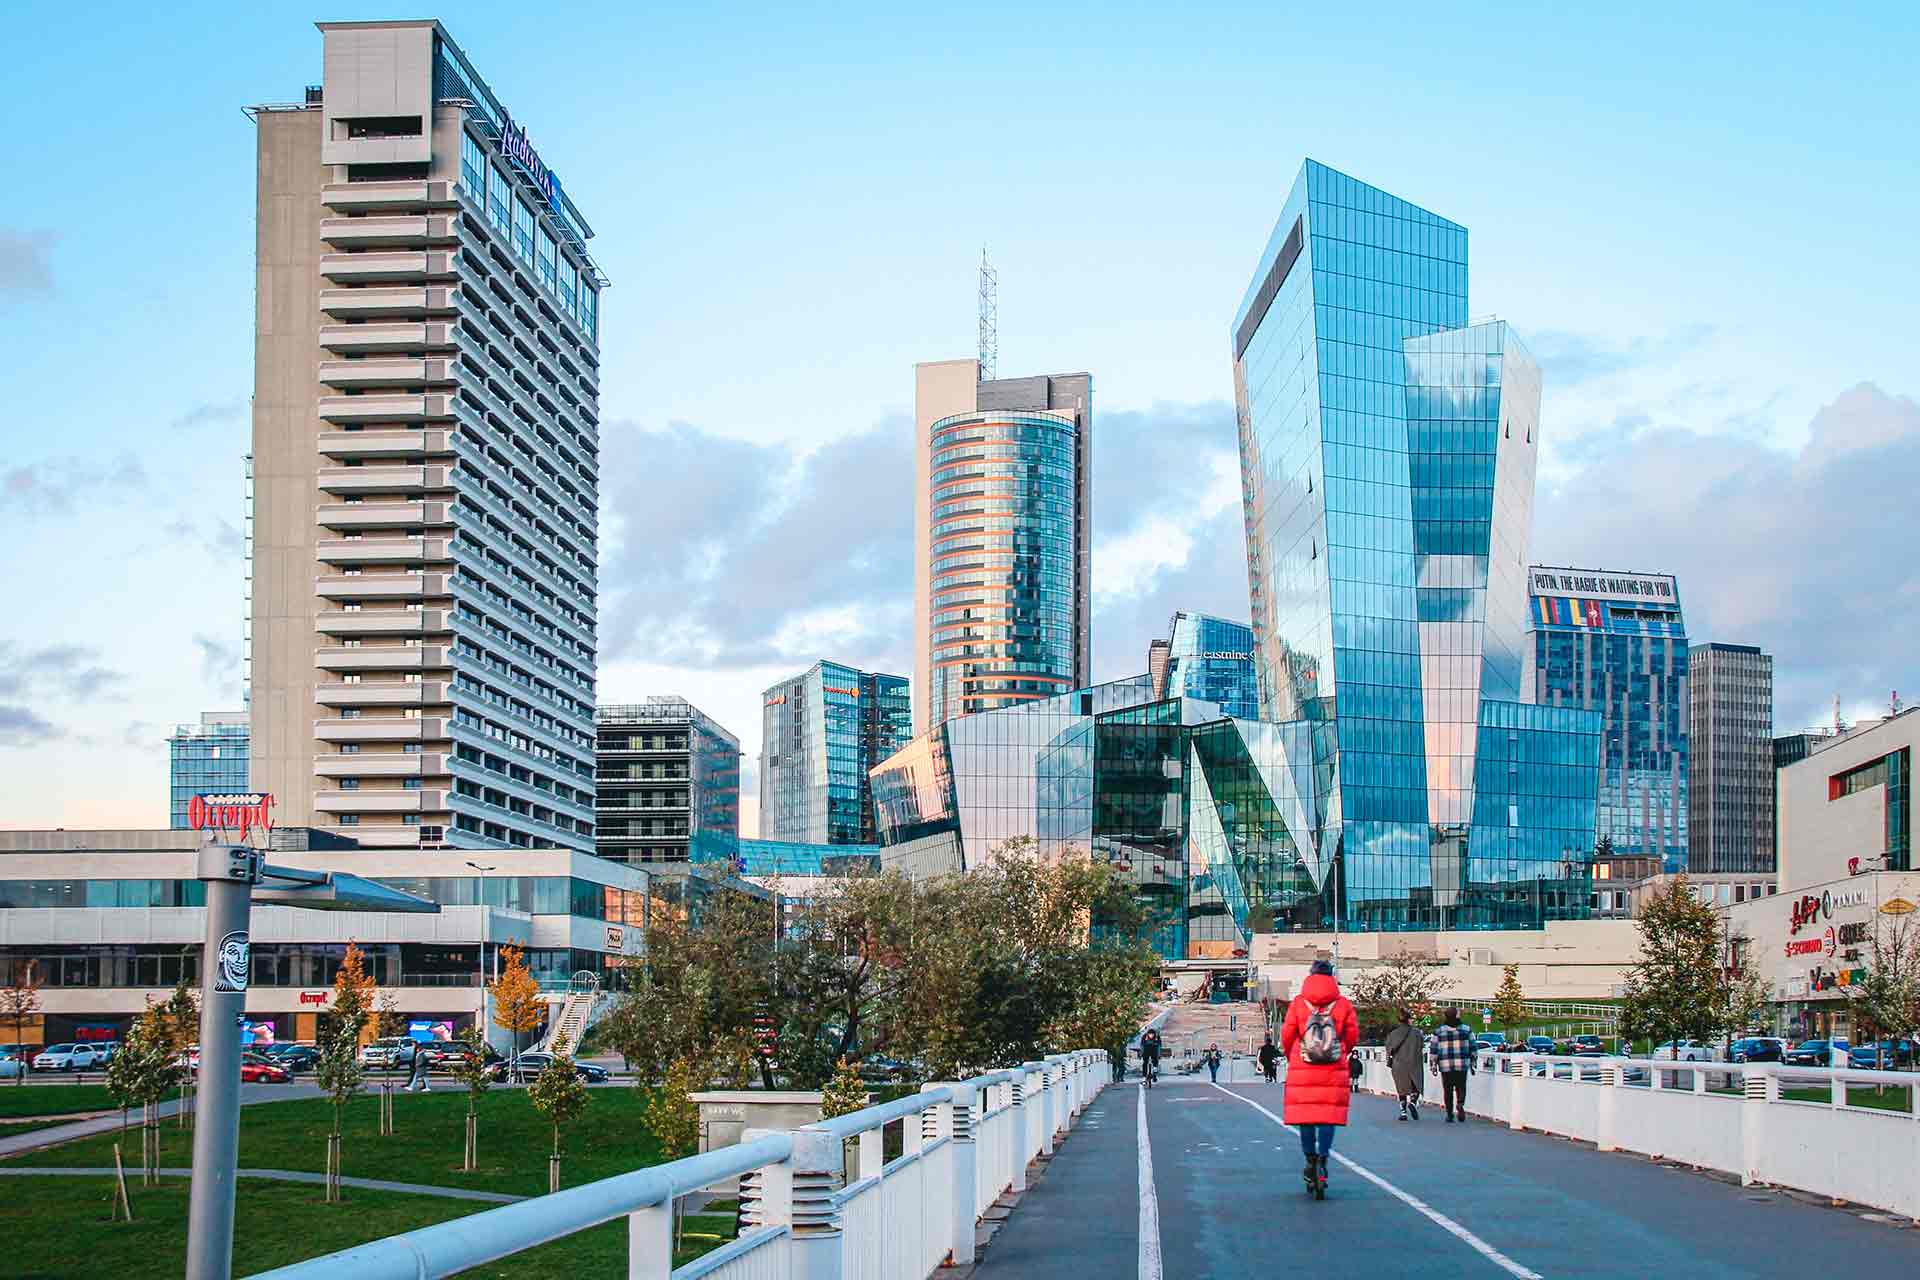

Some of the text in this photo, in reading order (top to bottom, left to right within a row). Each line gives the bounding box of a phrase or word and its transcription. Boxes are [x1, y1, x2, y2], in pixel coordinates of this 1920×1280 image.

[1534, 573, 1671, 597] PUTIN, THE HAGUE IS WAITING FOR YOU
